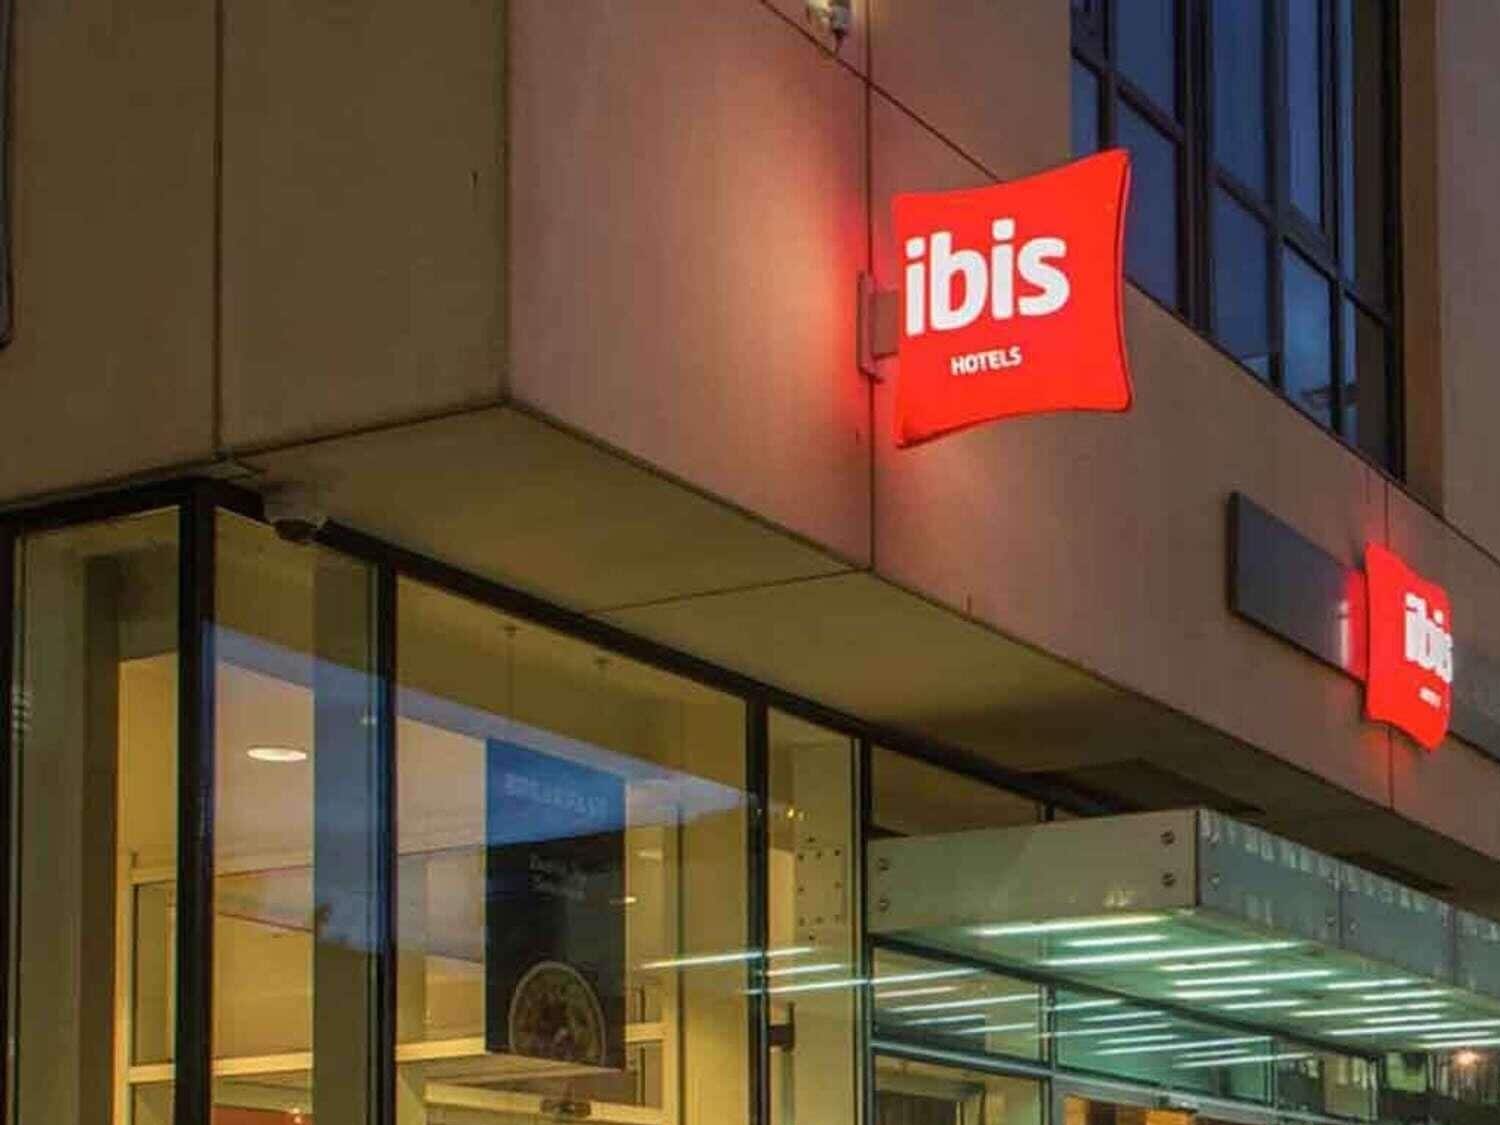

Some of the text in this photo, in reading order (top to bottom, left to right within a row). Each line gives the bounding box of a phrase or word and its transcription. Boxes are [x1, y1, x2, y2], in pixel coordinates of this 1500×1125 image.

[906, 217, 1070, 337] ibis
[951, 346, 1022, 376] HOTELS
[1405, 592, 1452, 683] ibis
